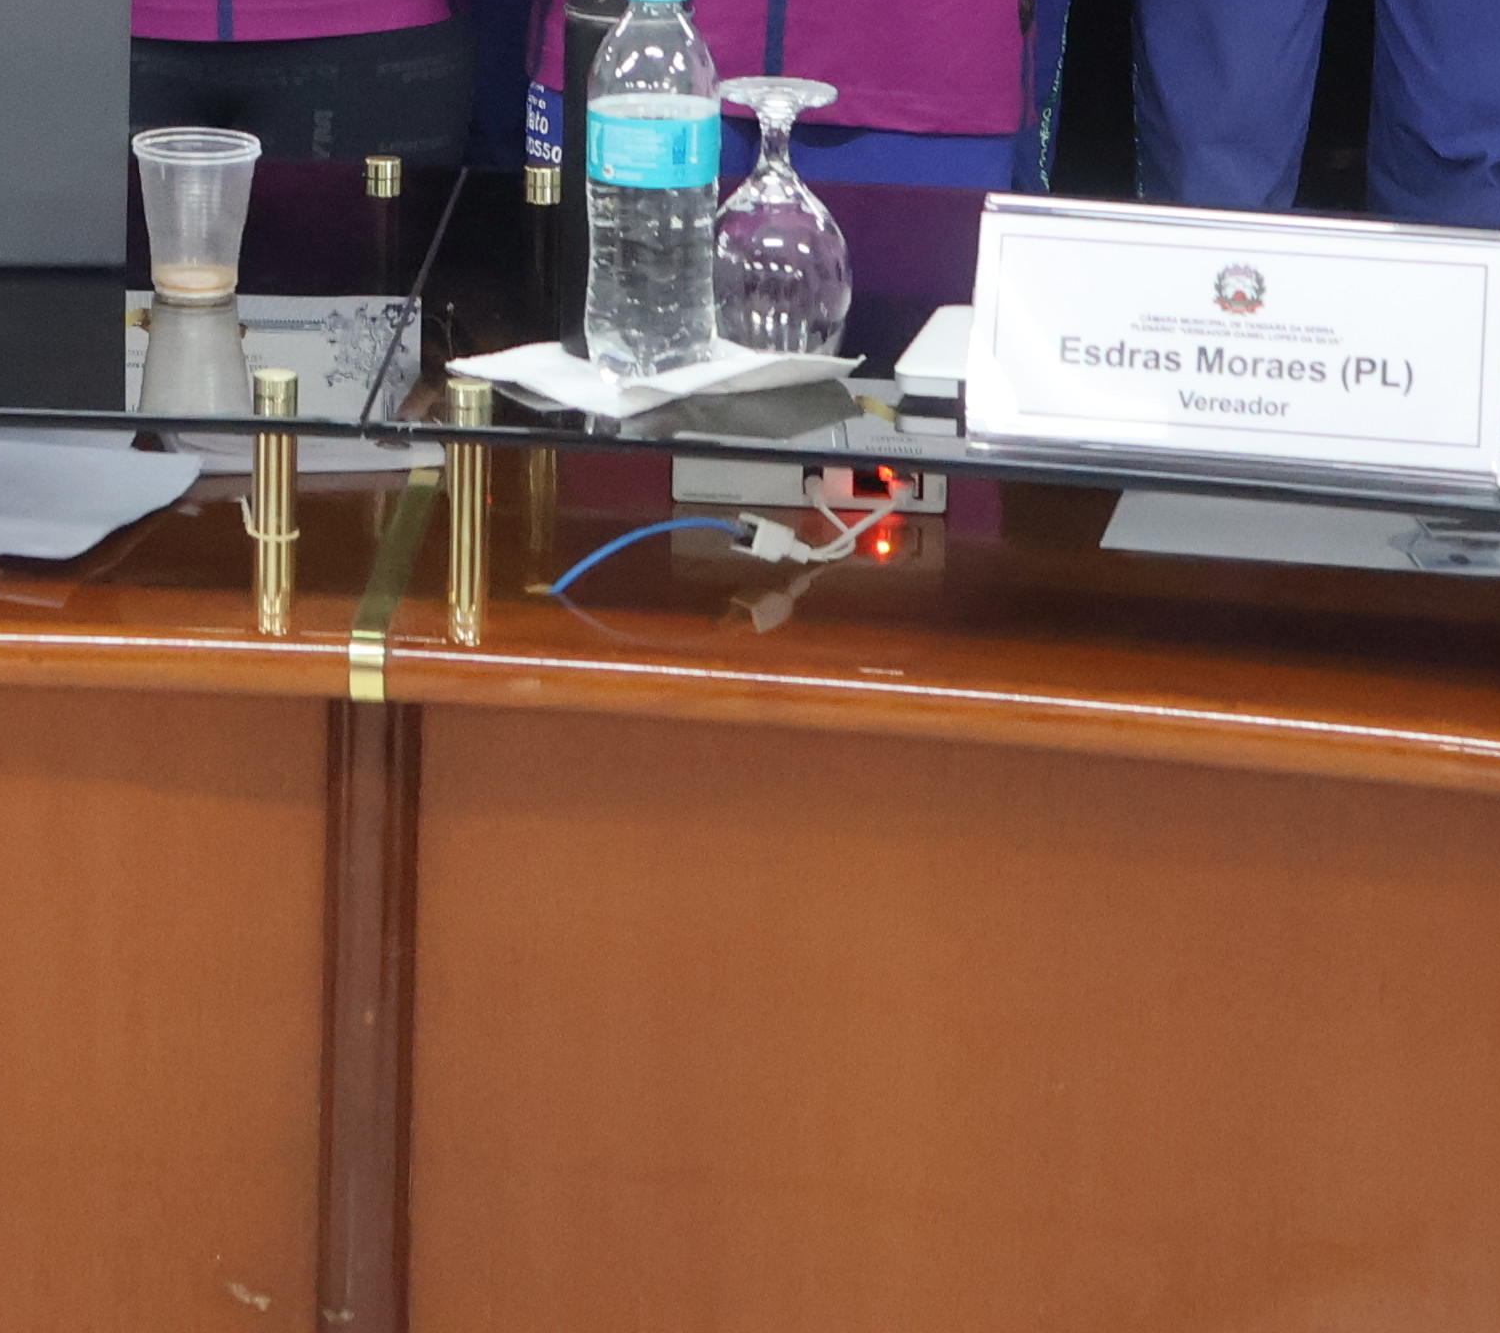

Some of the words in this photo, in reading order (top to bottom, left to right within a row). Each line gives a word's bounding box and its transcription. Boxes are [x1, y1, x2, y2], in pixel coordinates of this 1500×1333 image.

[1060, 335, 1183, 373] Esdras
[1196, 347, 1328, 384] Moraes
[1340, 355, 1415, 397] (PL)
[1178, 389, 1291, 419] Vereador
